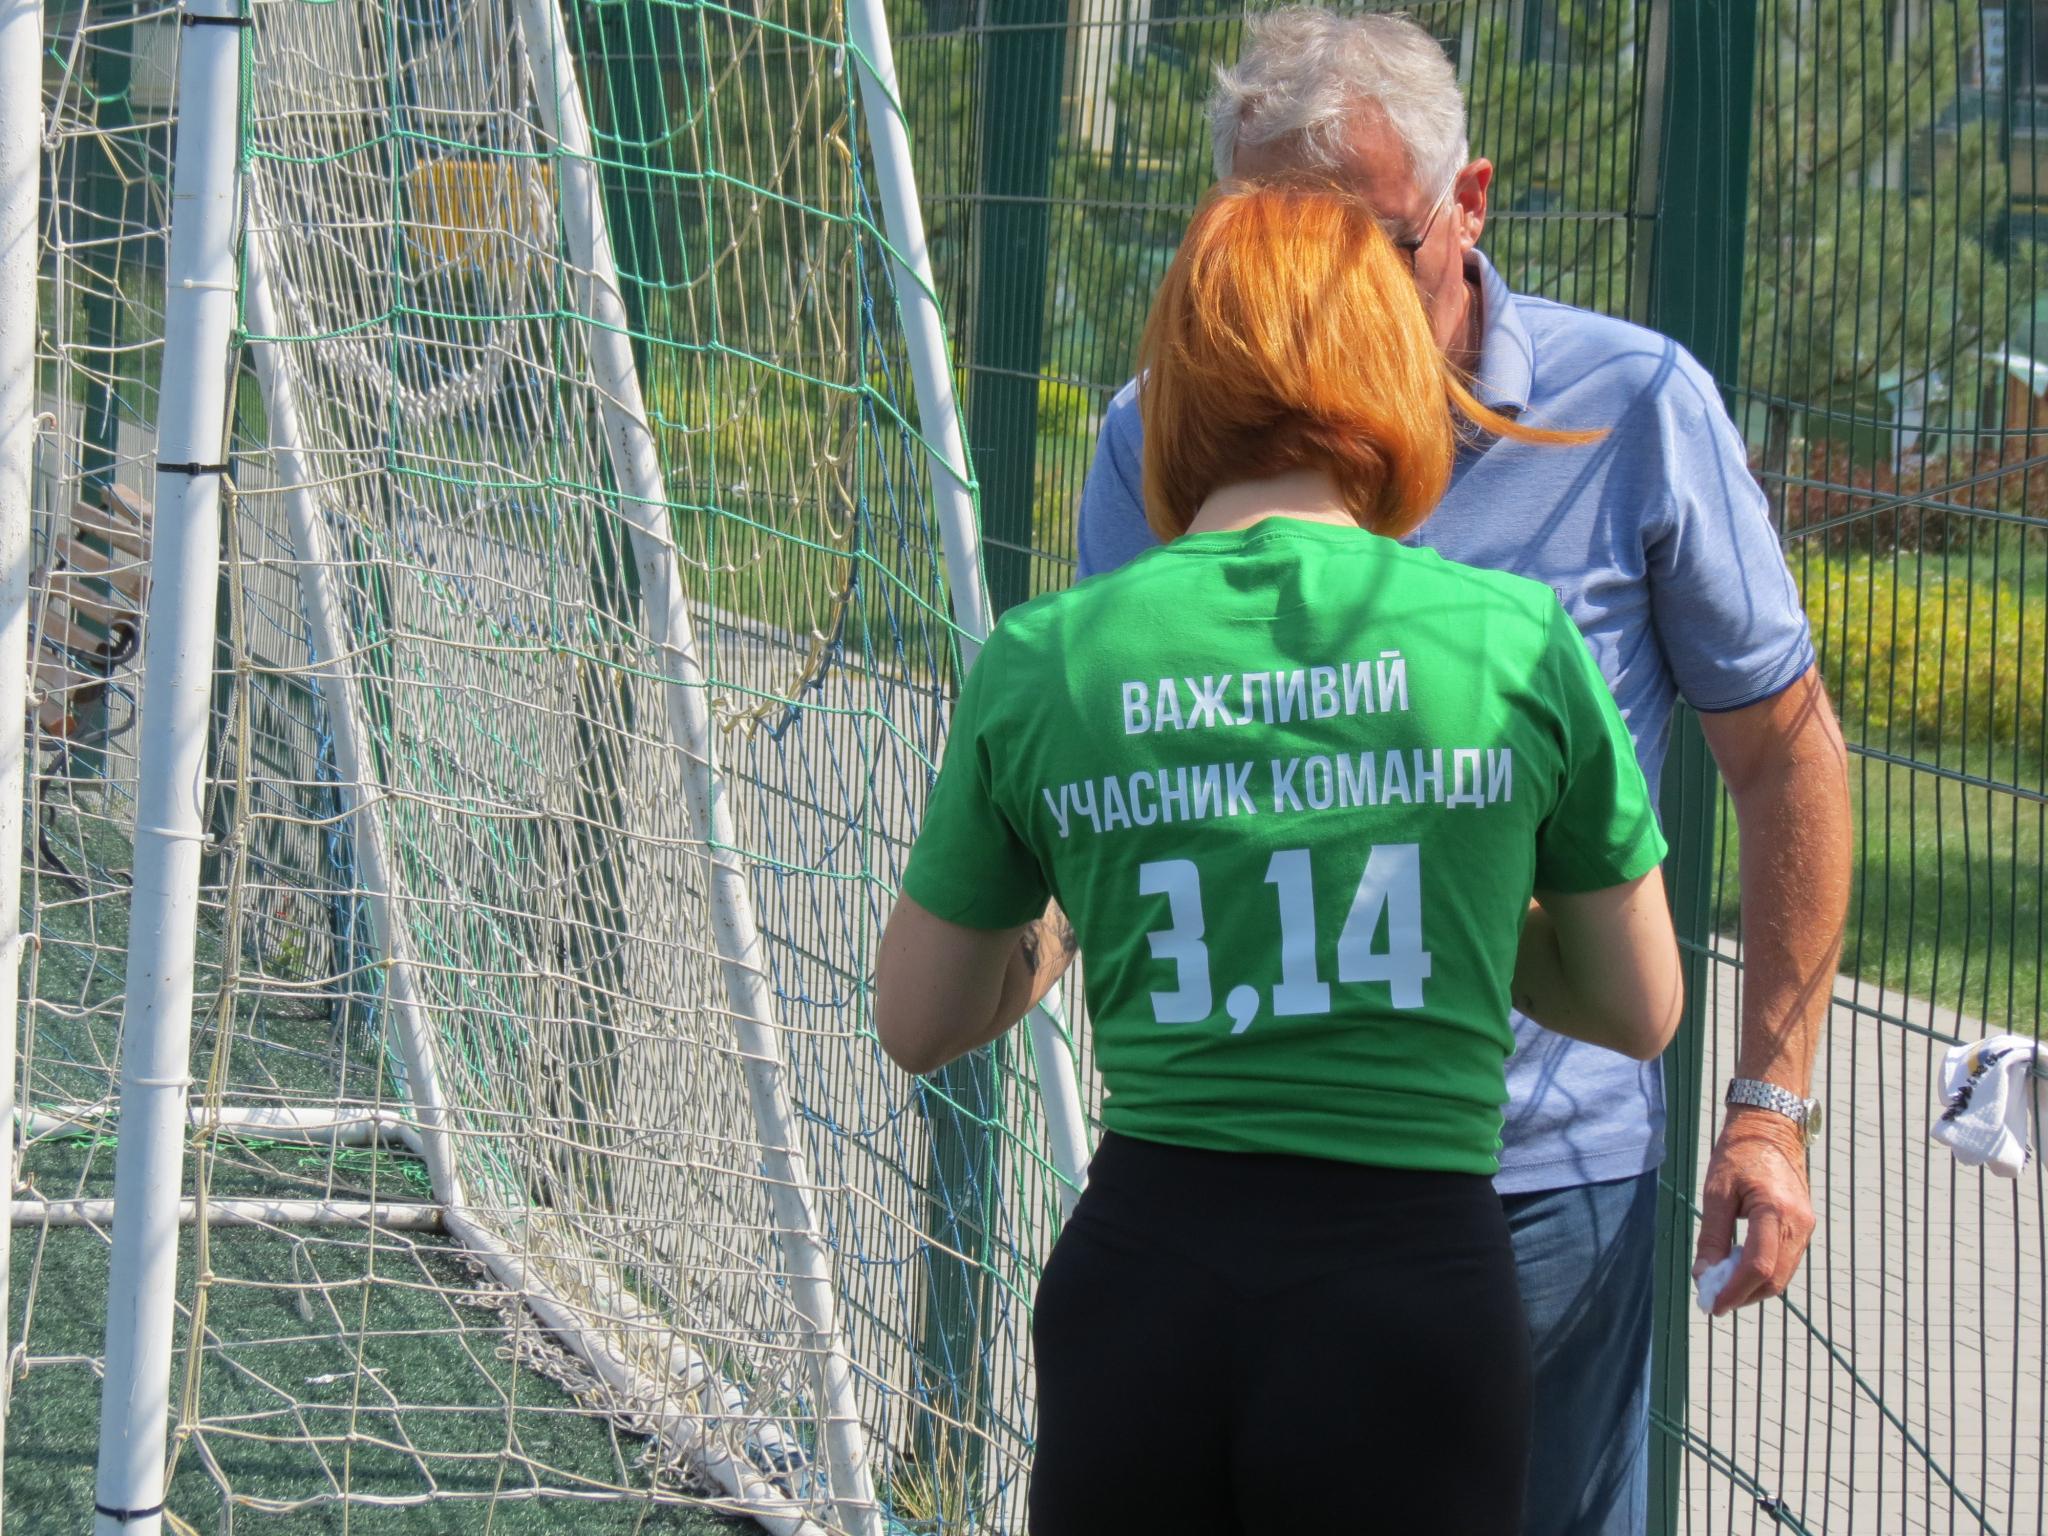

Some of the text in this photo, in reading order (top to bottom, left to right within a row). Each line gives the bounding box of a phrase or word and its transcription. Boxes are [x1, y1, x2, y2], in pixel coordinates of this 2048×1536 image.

[1122, 649, 1409, 735] ВАЖЛИВИЙ
[1043, 748, 1513, 838] УЧАСНИК КОМАНДИ
[1139, 843, 1432, 1034] 3,14
